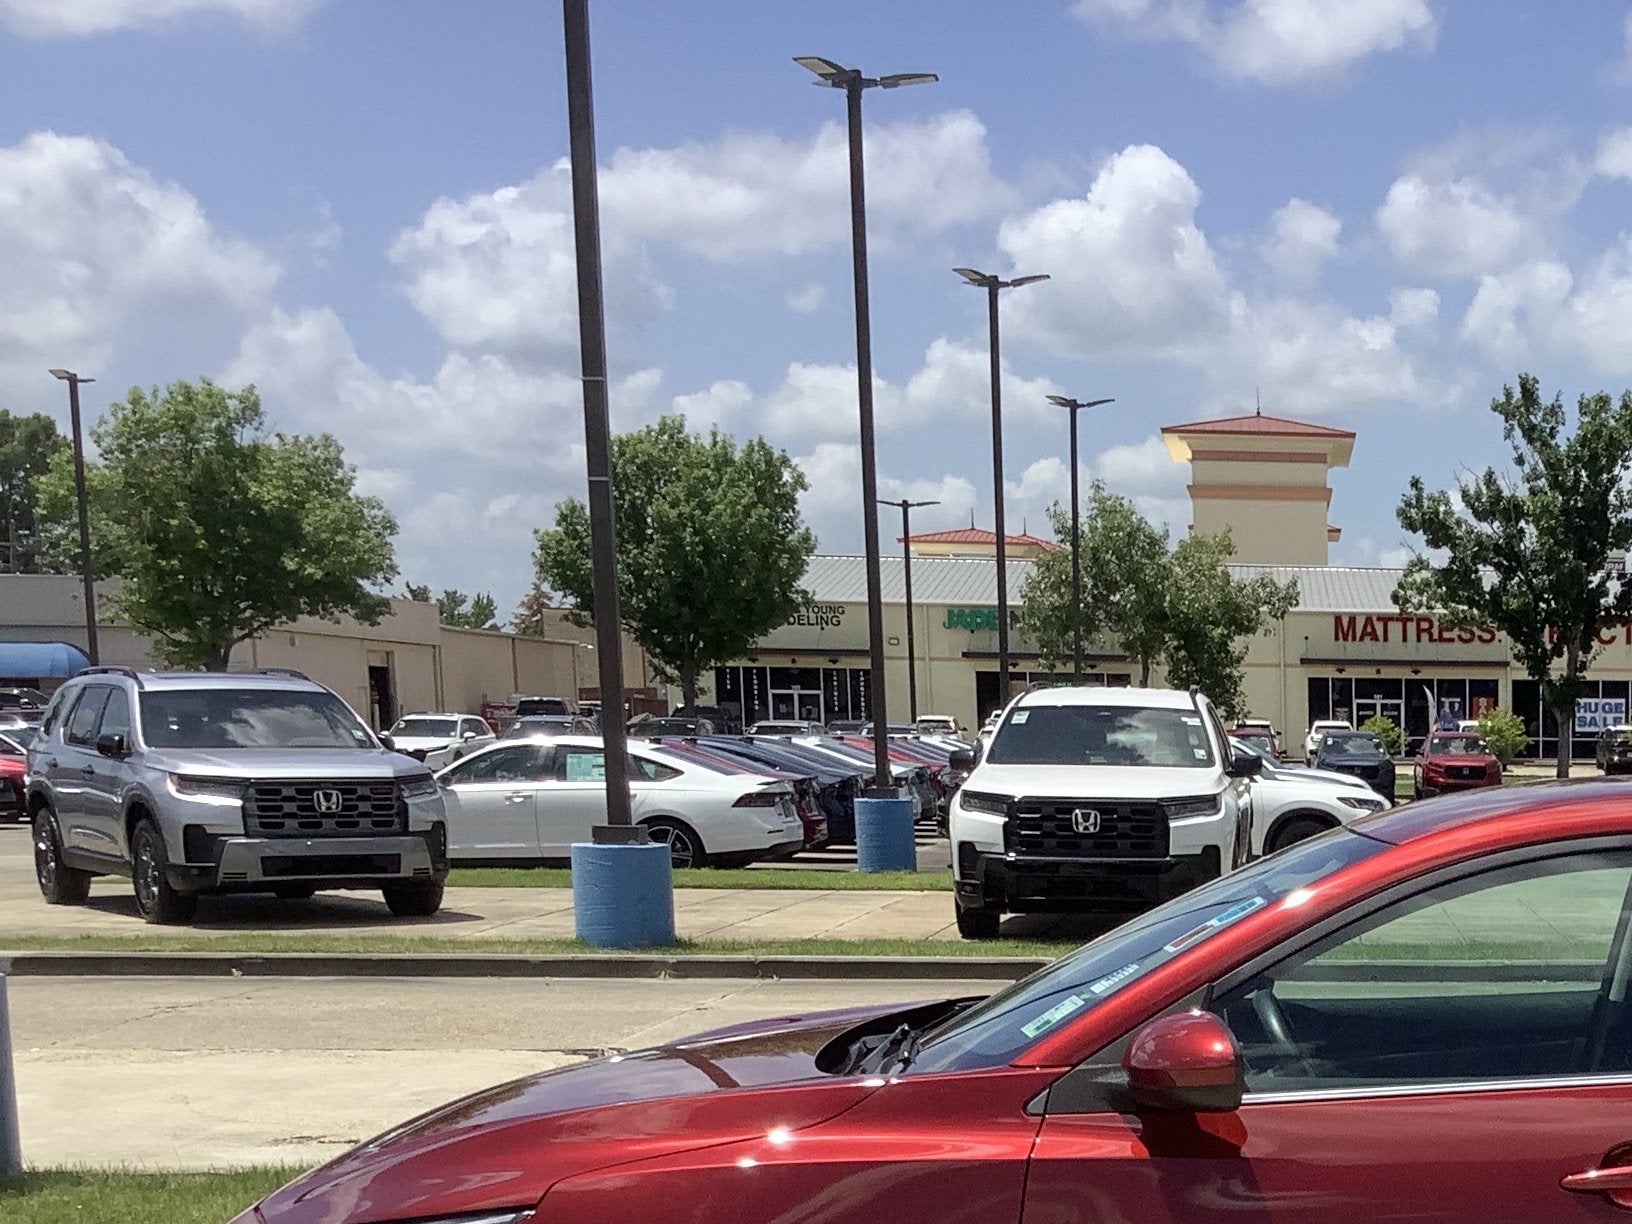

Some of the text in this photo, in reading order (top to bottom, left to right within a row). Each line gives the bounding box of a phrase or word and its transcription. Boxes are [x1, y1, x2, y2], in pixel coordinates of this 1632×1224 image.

[805, 604, 846, 615] YOUNG
[1333, 614, 1497, 644] MATTRESS
[1577, 701, 1625, 714] HUGE
[1577, 715, 1623, 728] SALE
